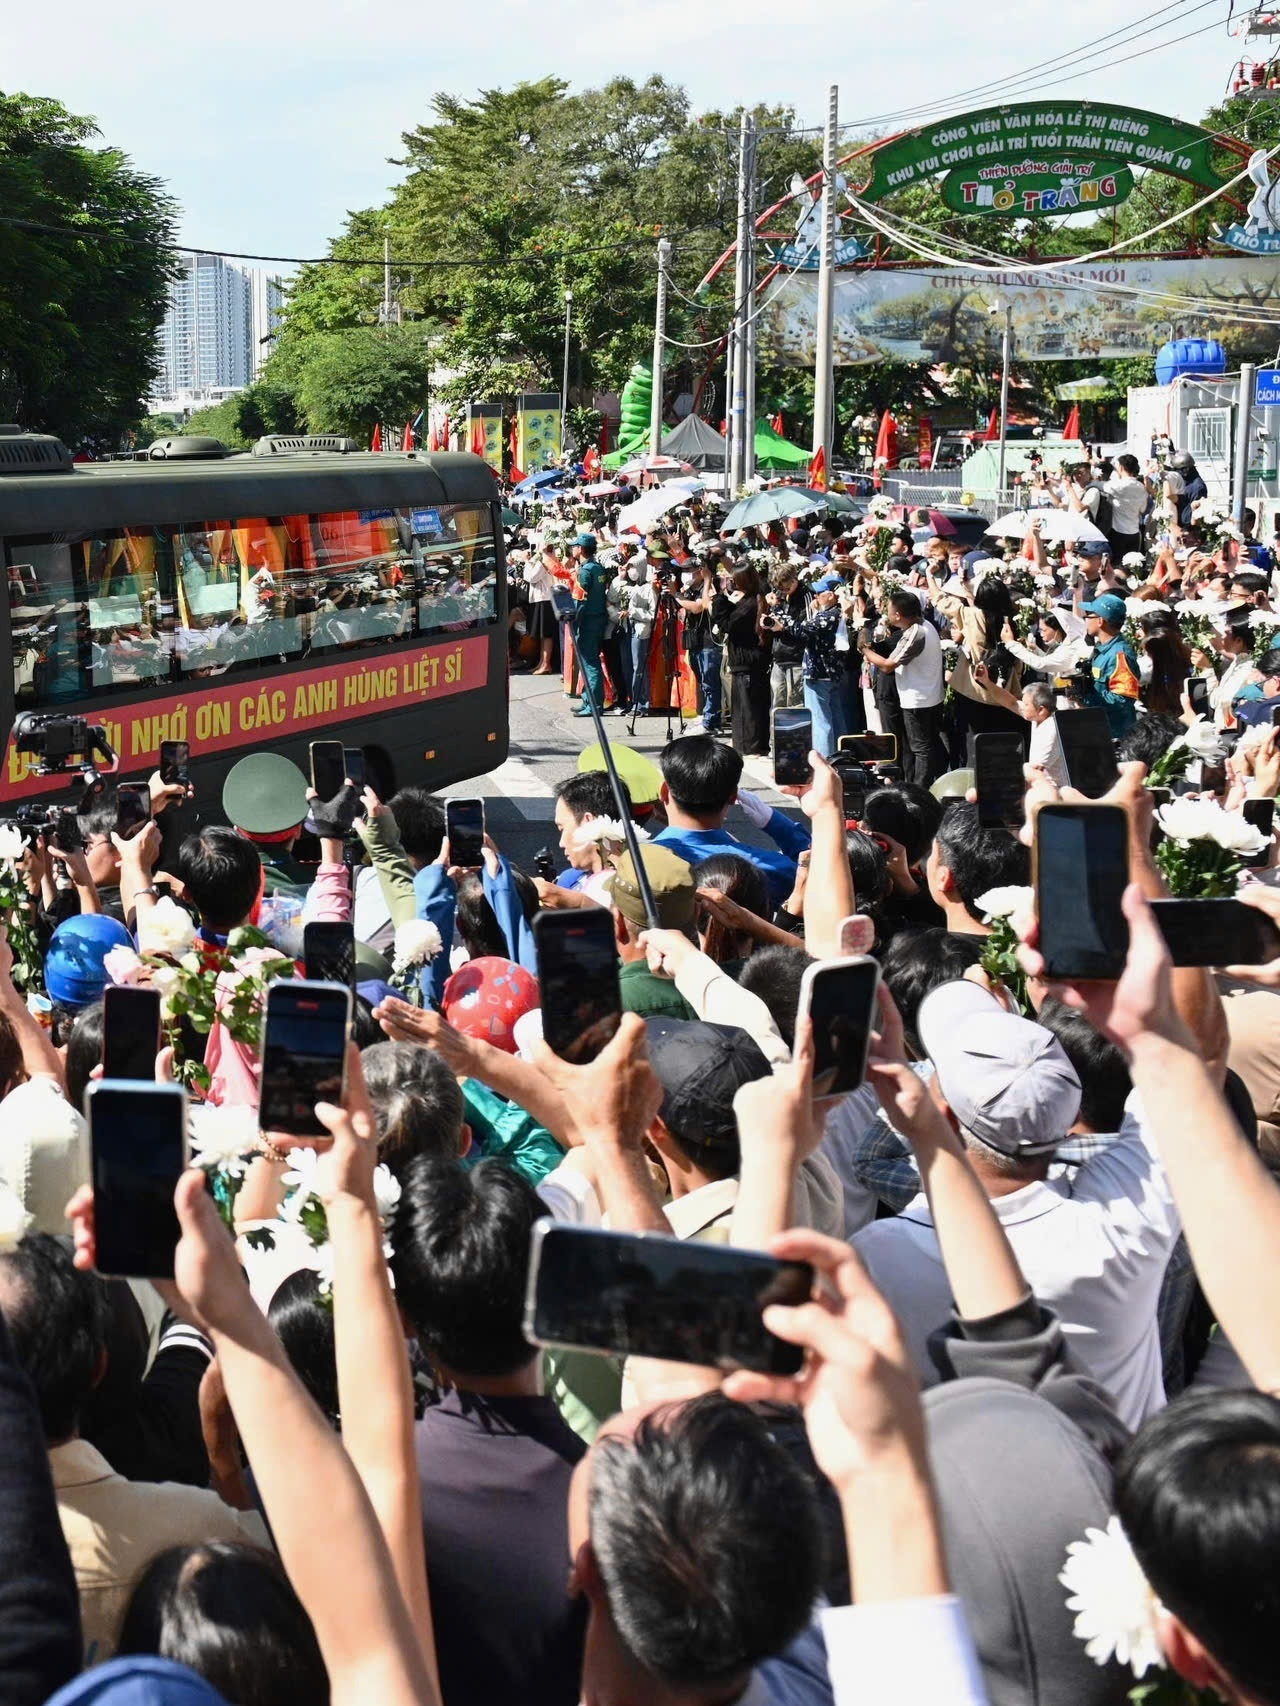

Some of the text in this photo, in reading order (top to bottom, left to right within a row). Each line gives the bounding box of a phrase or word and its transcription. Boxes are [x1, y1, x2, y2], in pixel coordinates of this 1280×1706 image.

[931, 109, 1150, 147] CÔNG VIÊN VĂN HÓA LÊ THỊ RIÊNG
[886, 127, 1192, 186] KHU VUI CHƠI GIẢI TRÍ TUỔI THẦN TIÊN QUẬN 10
[978, 161, 1010, 181] THIÊN
[1050, 158, 1073, 175] GIẢI
[1075, 160, 1096, 177] TRÍ
[960, 174, 1117, 212] THỎ TRẮNG
[931, 271, 982, 289] CHÚC
[1089, 266, 1126, 283] MỚI
[1258, 386, 1275, 401] CÁCH
[131, 702, 188, 755] NHỚ
[195, 700, 231, 740] ƠN
[239, 686, 286, 731] CÁC
[293, 679, 338, 720] ANH
[343, 665, 398, 707] HÙNG
[403, 654, 440, 696] LIỆT
[445, 647, 464, 683] SĨ
